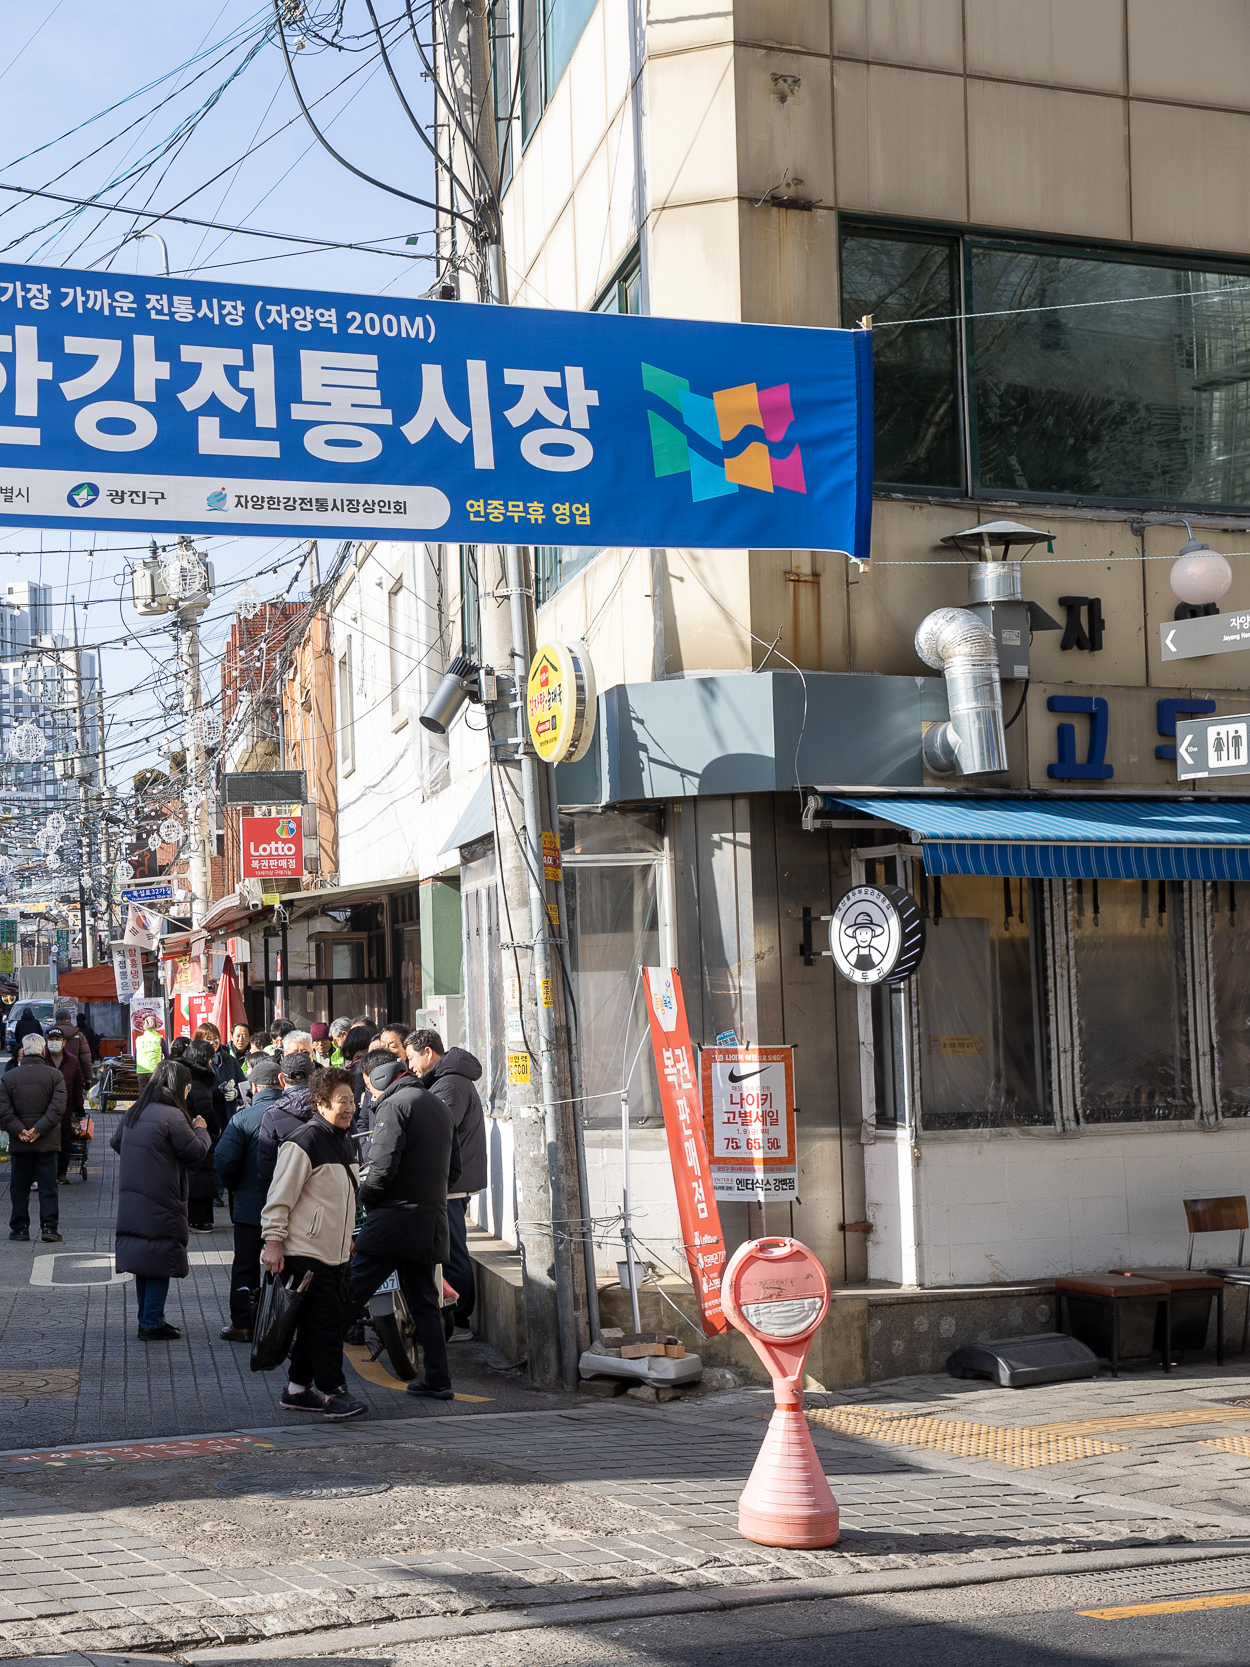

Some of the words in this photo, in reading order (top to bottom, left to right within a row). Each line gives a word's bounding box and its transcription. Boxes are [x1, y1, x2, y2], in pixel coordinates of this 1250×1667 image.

[0, 281, 52, 311] 가장
[60, 286, 138, 318] 가까운
[145, 294, 246, 327] 전통시장
[254, 300, 338, 335] (자양역
[346, 309, 437, 344] 200M)
[106, 488, 166, 506] 광진구
[234, 493, 408, 516] 자양한강전통시장상인회
[465, 498, 545, 524] 연중무휴
[551, 502, 591, 526] 영업
[250, 841, 296, 856] Lotto
[251, 858, 296, 870] 복권판매점
[128, 948, 140, 991] 함흥냉면
[662, 1046, 693, 1092] 복권
[730, 1092, 772, 1109] 나이키
[722, 1109, 780, 1126] 고별세일
[676, 1096, 708, 1220] 판매점
[736, 1178, 772, 1192] 엔터식스
[773, 1178, 795, 1192] 강변점
